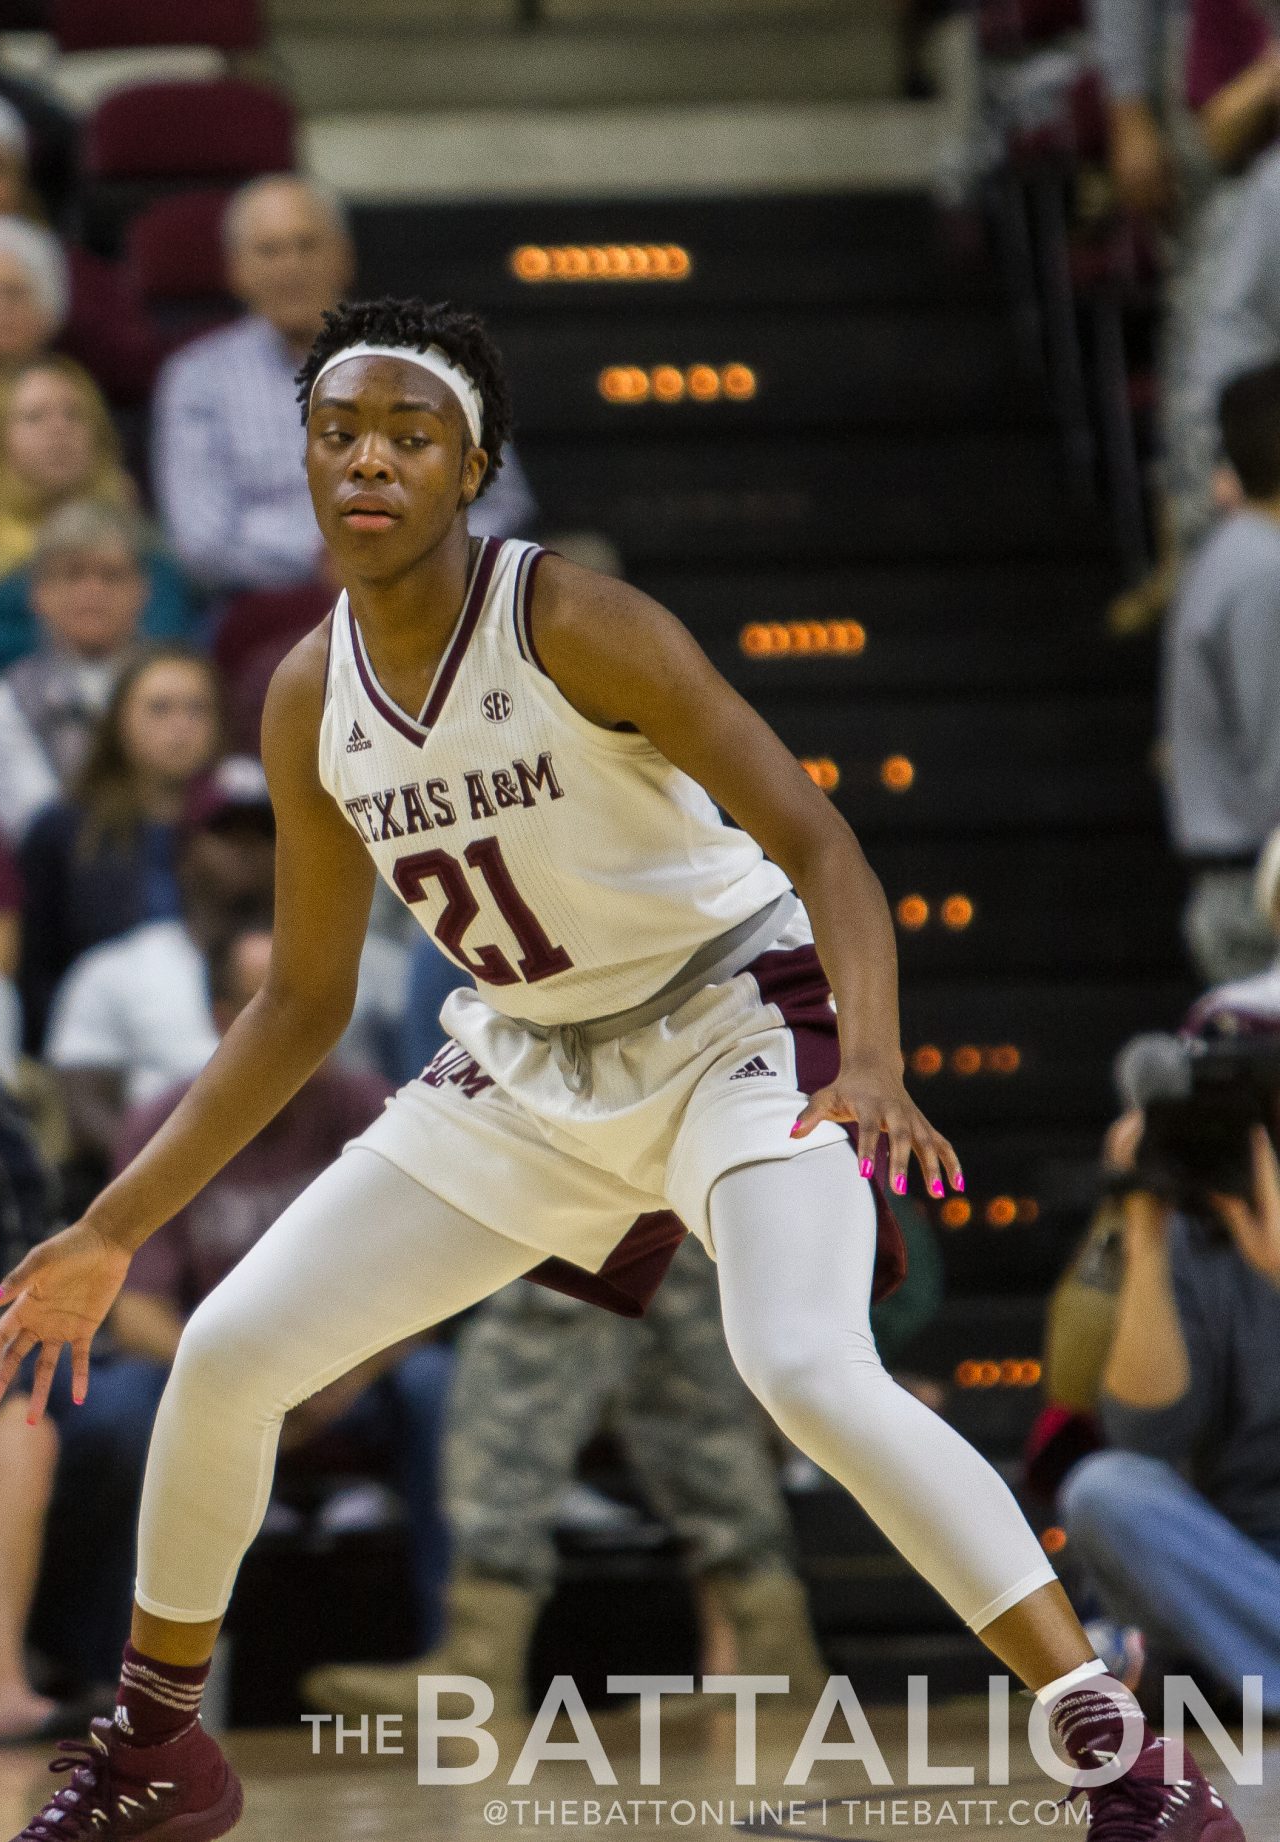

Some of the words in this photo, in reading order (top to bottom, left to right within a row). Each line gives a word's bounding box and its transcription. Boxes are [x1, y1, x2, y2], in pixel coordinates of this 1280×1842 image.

[483, 692, 510, 720] SEC
[346, 740, 372, 753] adidas
[344, 778, 457, 843] TEXAS
[464, 752, 565, 820] A&M
[393, 836, 575, 986] 21
[729, 1069, 777, 1080] adidas
